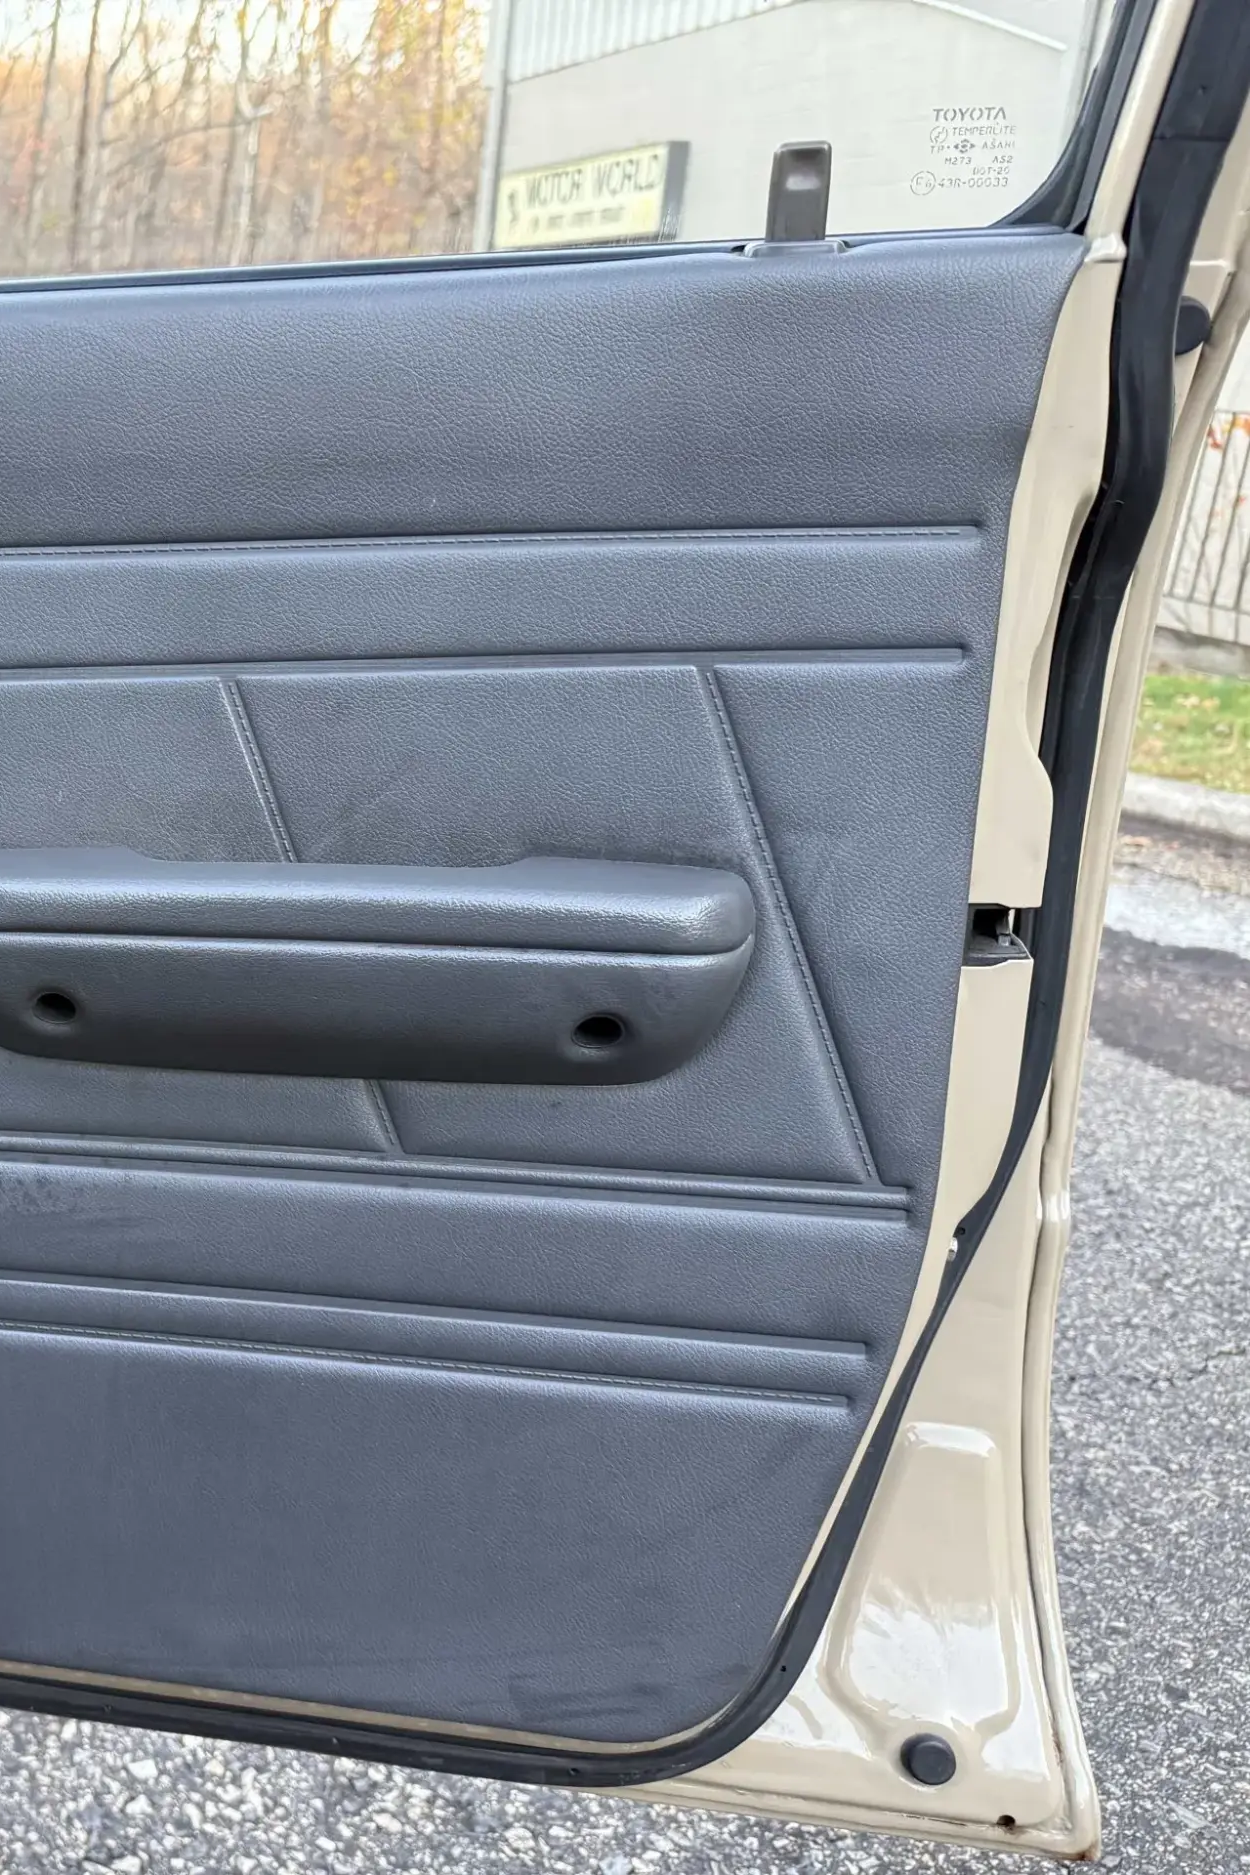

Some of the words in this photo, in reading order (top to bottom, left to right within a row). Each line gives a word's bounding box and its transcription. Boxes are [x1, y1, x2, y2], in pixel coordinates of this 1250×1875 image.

[933, 107, 1006, 122] TOYOTA
[952, 125, 1016, 136] TEMPERLITE
[944, 156, 972, 166] M273
[992, 155, 1014, 164] AS2
